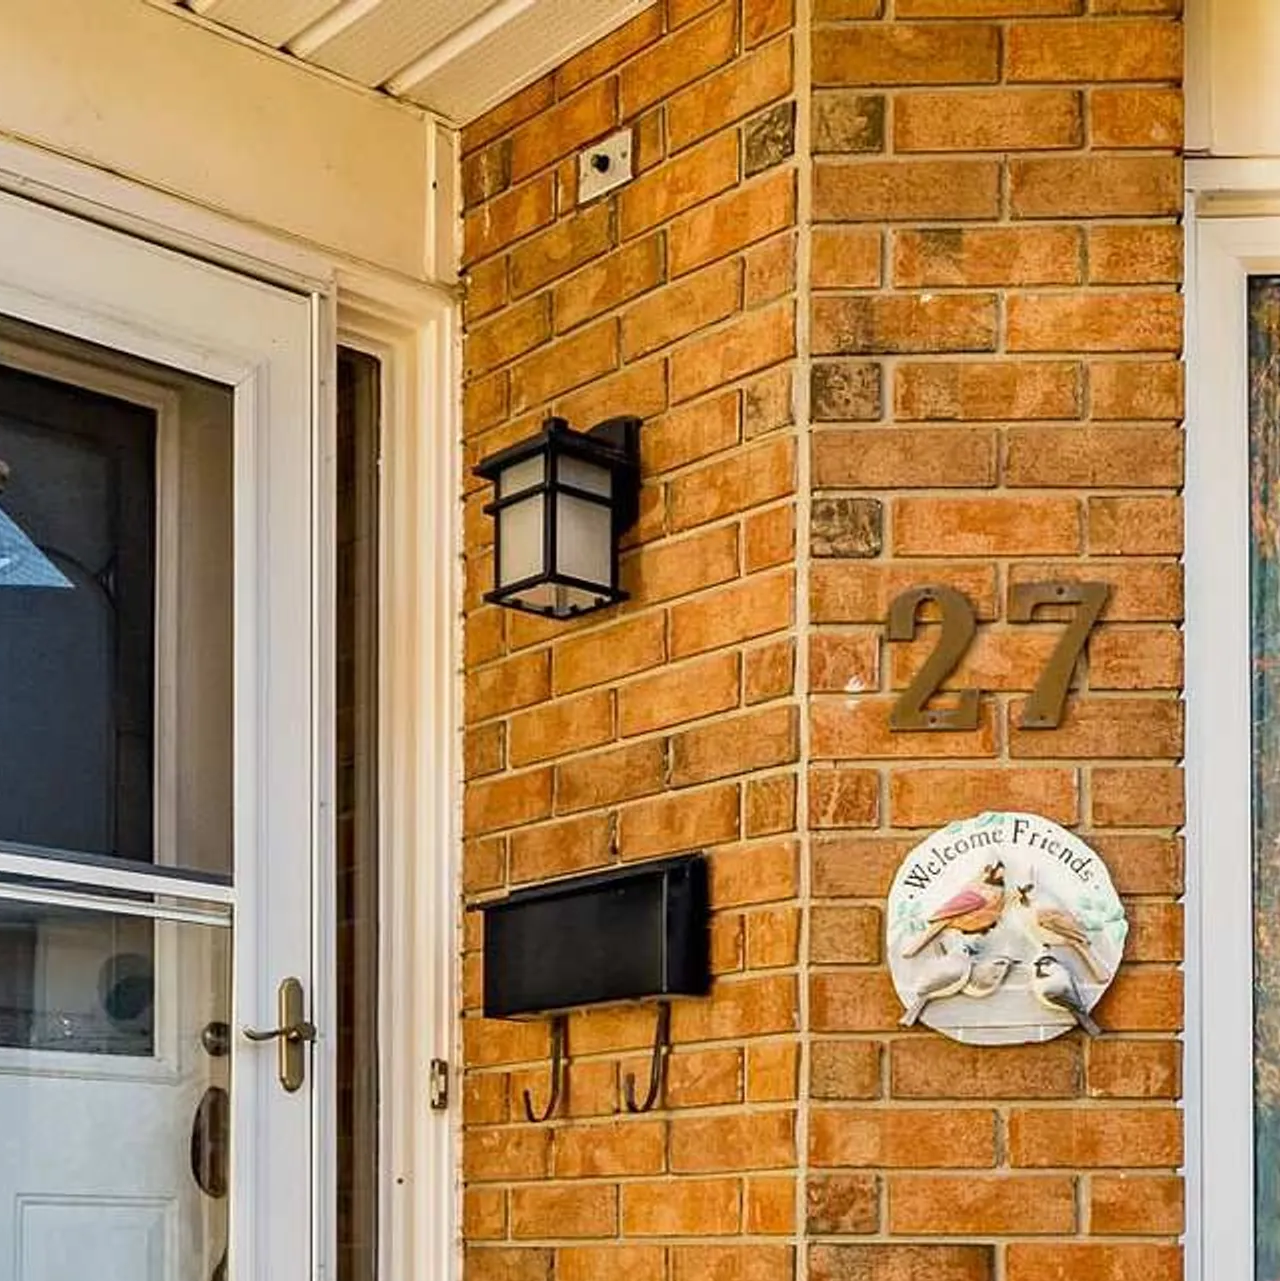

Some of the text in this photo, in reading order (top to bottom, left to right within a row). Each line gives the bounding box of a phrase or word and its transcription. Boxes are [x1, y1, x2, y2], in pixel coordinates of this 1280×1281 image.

[887, 582, 1111, 732] 27
[904, 818, 1095, 890] Welcome Friends
